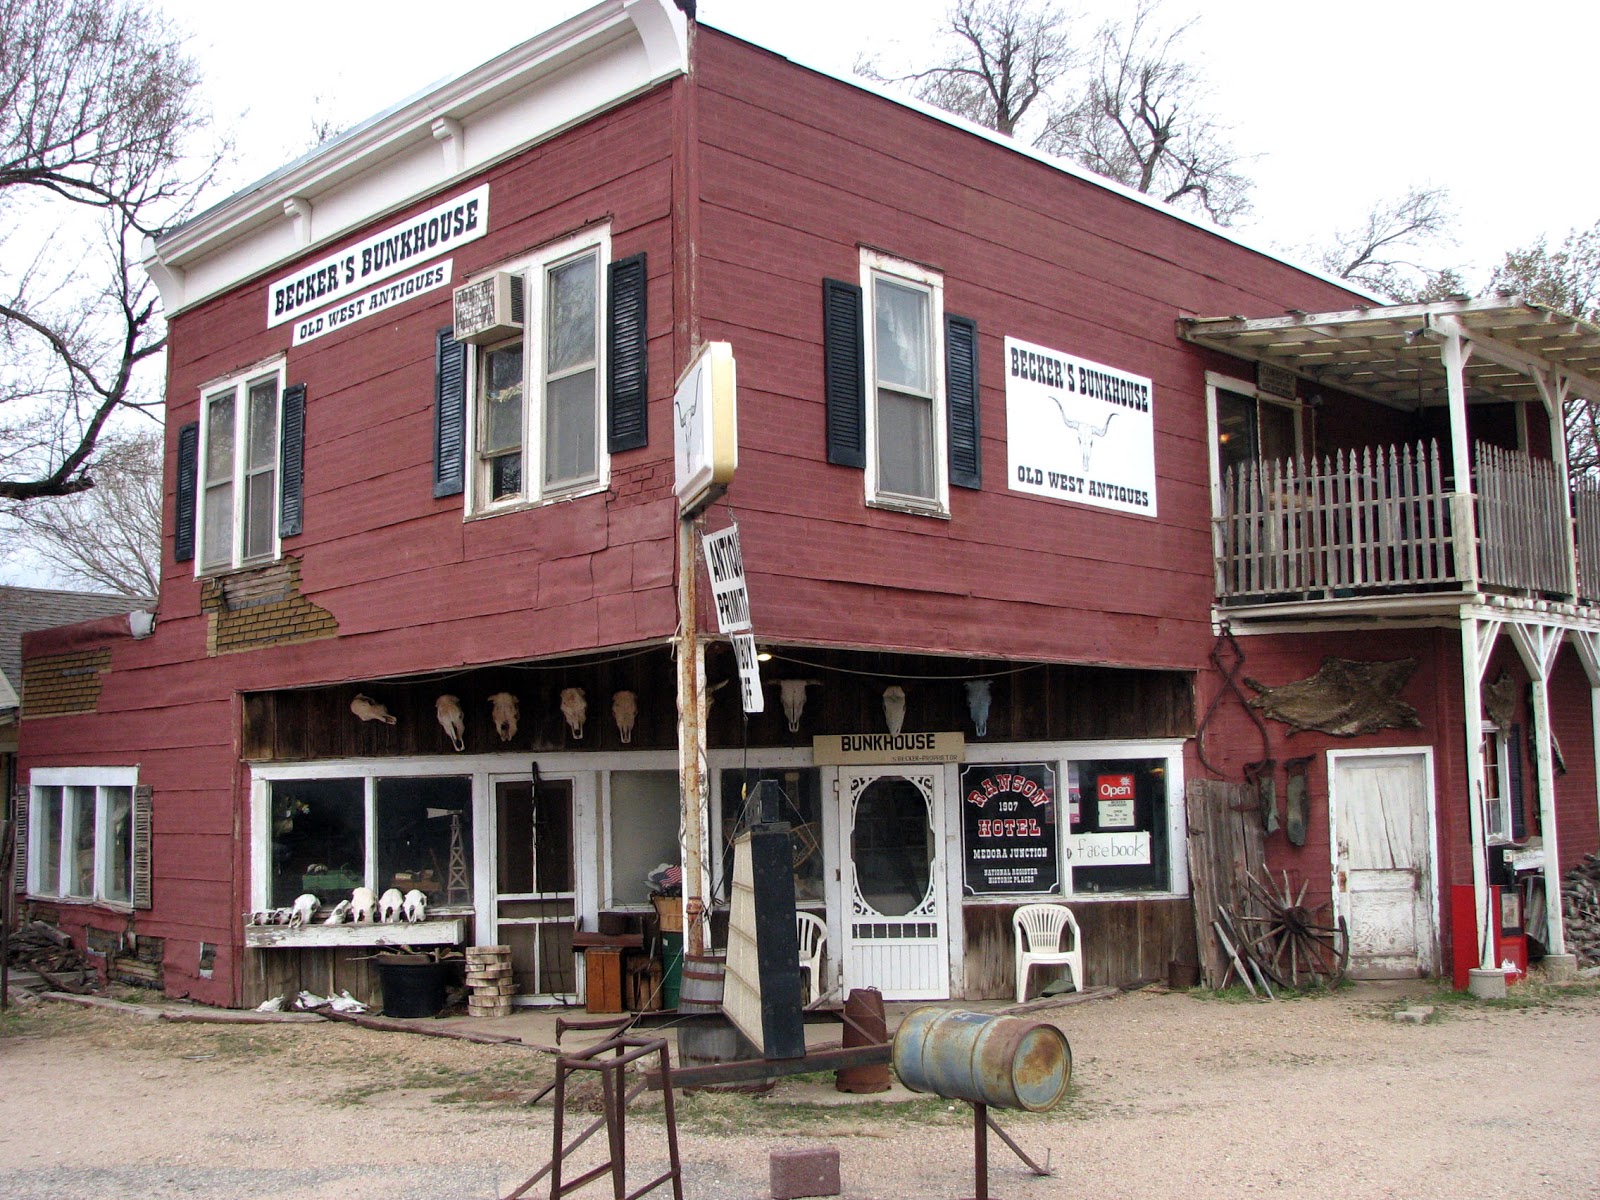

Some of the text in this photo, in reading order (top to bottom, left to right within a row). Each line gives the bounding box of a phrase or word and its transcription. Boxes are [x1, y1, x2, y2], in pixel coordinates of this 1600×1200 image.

[275, 199, 479, 316] BECKER'S BUNKHOUSE
[299, 266, 444, 340] OLD WEST ANTIQUES
[1010, 347, 1149, 413] BECKER'S BUNKHOUSE
[1017, 465, 1149, 507] OLD WEST ANTIQUES
[841, 733, 936, 752] BUNKHOUSE
[967, 773, 1050, 808] RANSON
[1100, 784, 1131, 797] Open
[998, 801, 1019, 812] 1907
[978, 818, 1041, 837] HOTEL
[973, 847, 1048, 859] MEDORA JUNCTION
[983, 867, 1038, 877] NATIONAL REGISTER
[988, 875, 1034, 884] HISTORIC PLACES
